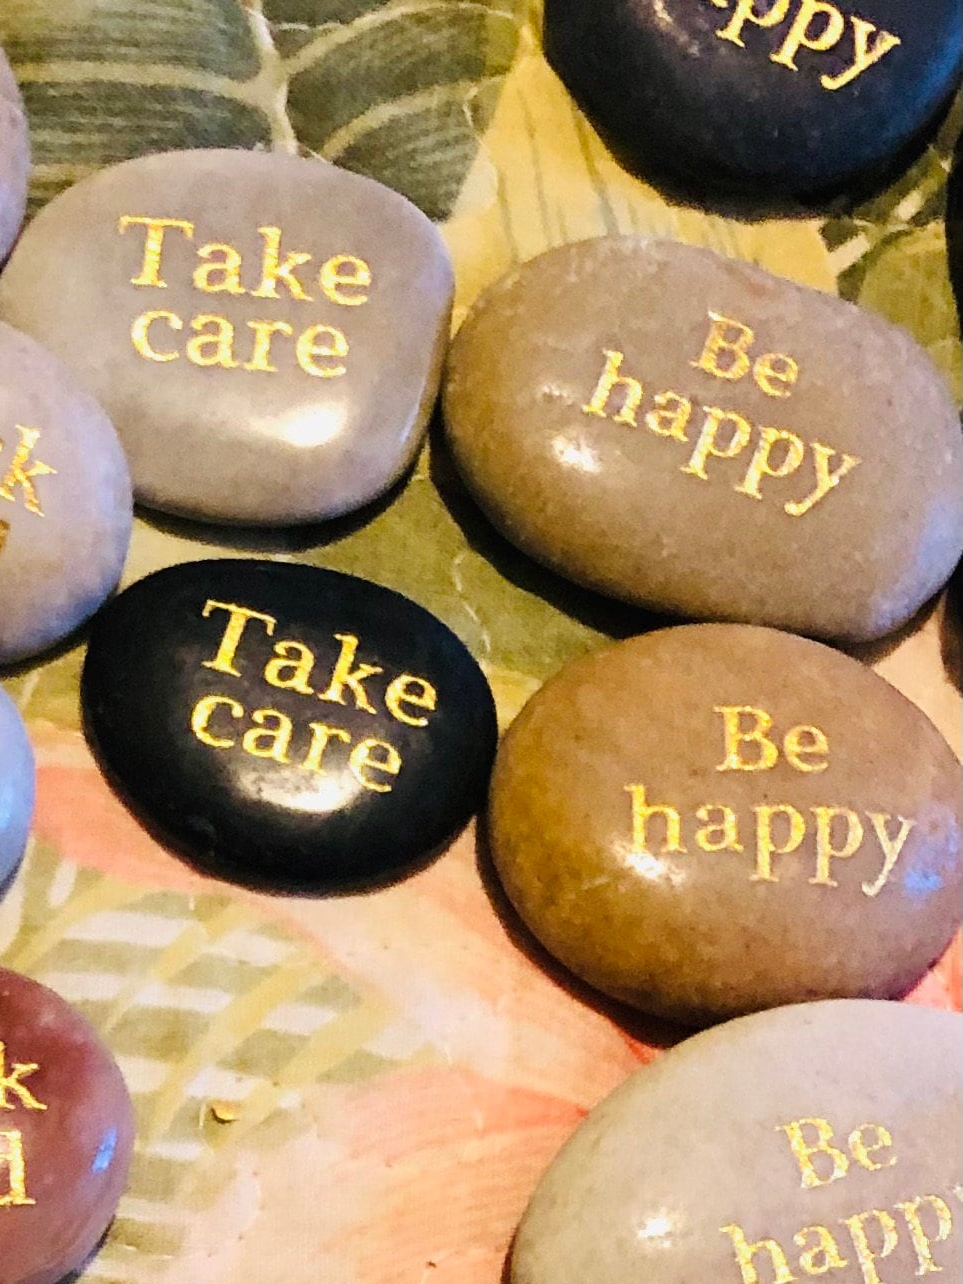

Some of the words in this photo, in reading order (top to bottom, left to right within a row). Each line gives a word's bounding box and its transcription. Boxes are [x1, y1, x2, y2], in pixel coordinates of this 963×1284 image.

[710, 0, 901, 90] ppy
[118, 214, 373, 306] Take
[130, 309, 350, 378] care
[689, 311, 798, 397] Be
[582, 349, 863, 517] happy
[201, 599, 437, 727] Take
[191, 695, 402, 793] care
[713, 705, 830, 774] Be
[623, 784, 916, 897] happy
[774, 1117, 898, 1189] Be
